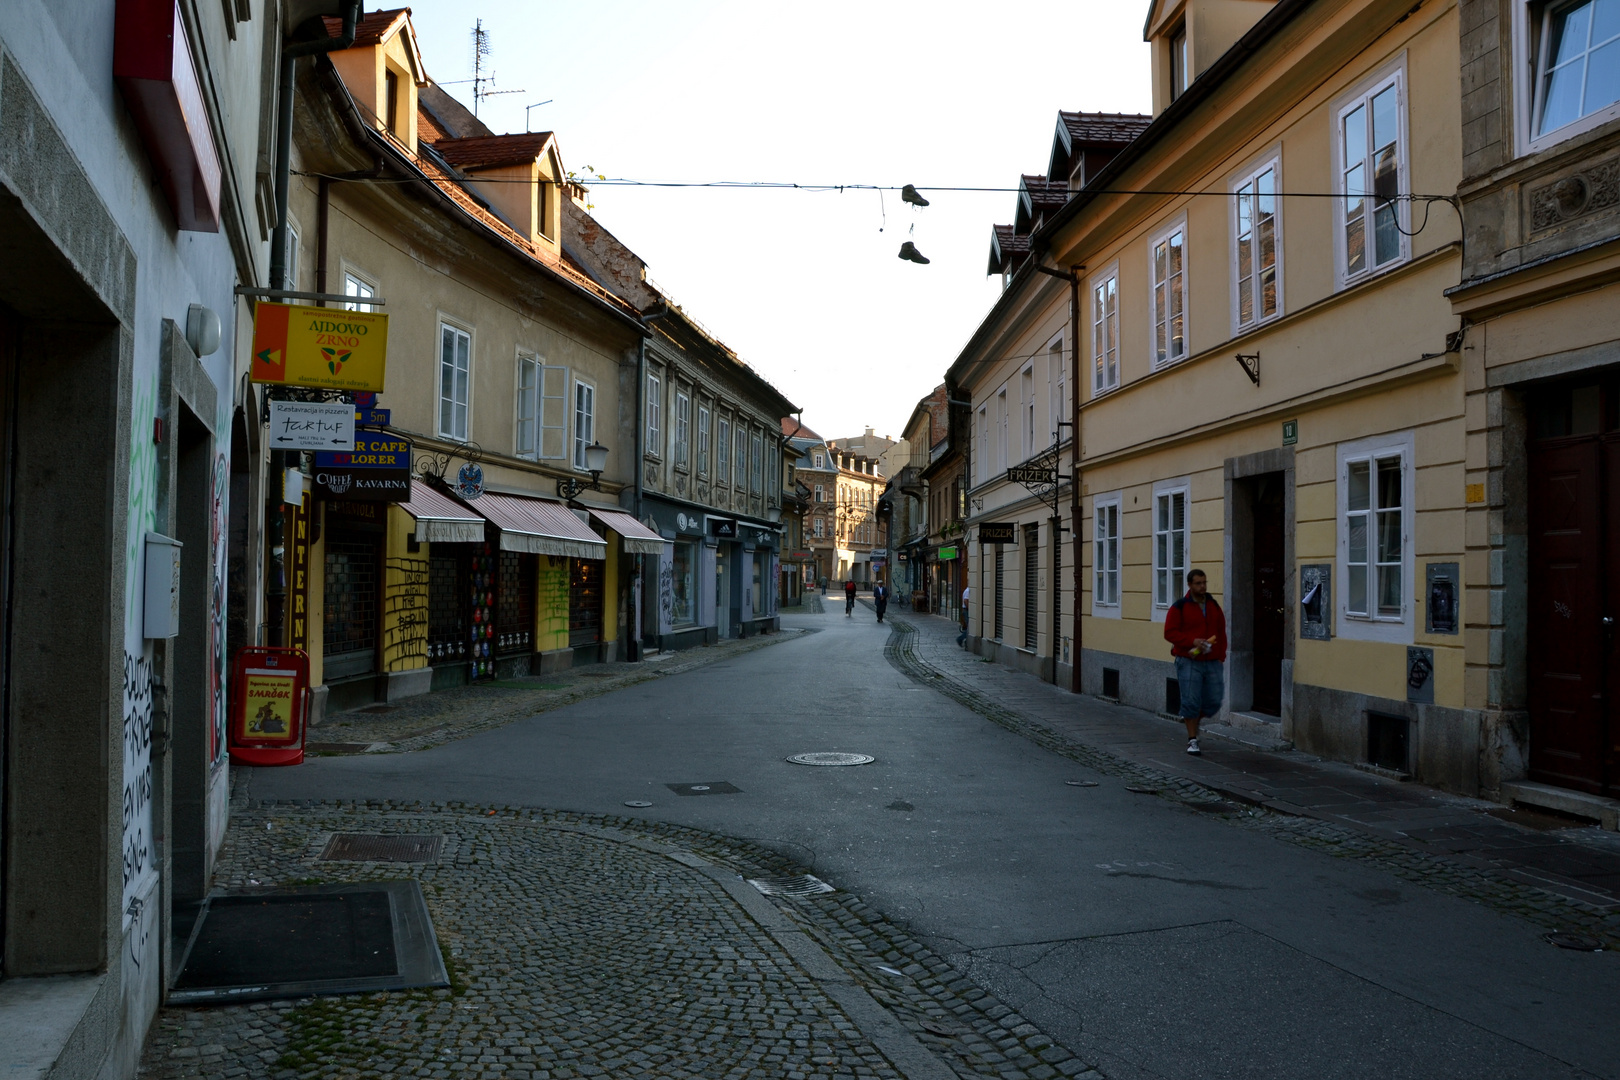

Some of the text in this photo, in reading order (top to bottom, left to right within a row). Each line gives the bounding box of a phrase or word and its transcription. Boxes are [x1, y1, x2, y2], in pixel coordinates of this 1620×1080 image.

[309, 320, 368, 336] AJDOVO
[316, 333, 360, 348] ZRNO
[320, 377, 345, 386] zalogaji
[346, 380, 369, 388] zdravja
[277, 405, 318, 414] Restavracija
[325, 407, 349, 416] pizzeria
[370, 412, 386, 423] 5m
[1286, 425, 1293, 437] 10
[370, 441, 408, 453] CAFE
[333, 453, 396, 465] XPLORER
[316, 472, 352, 485] COFFEE
[1009, 468, 1052, 483] FRIZER
[356, 479, 408, 489] KAVARNA
[981, 527, 1013, 540] FRIZER
